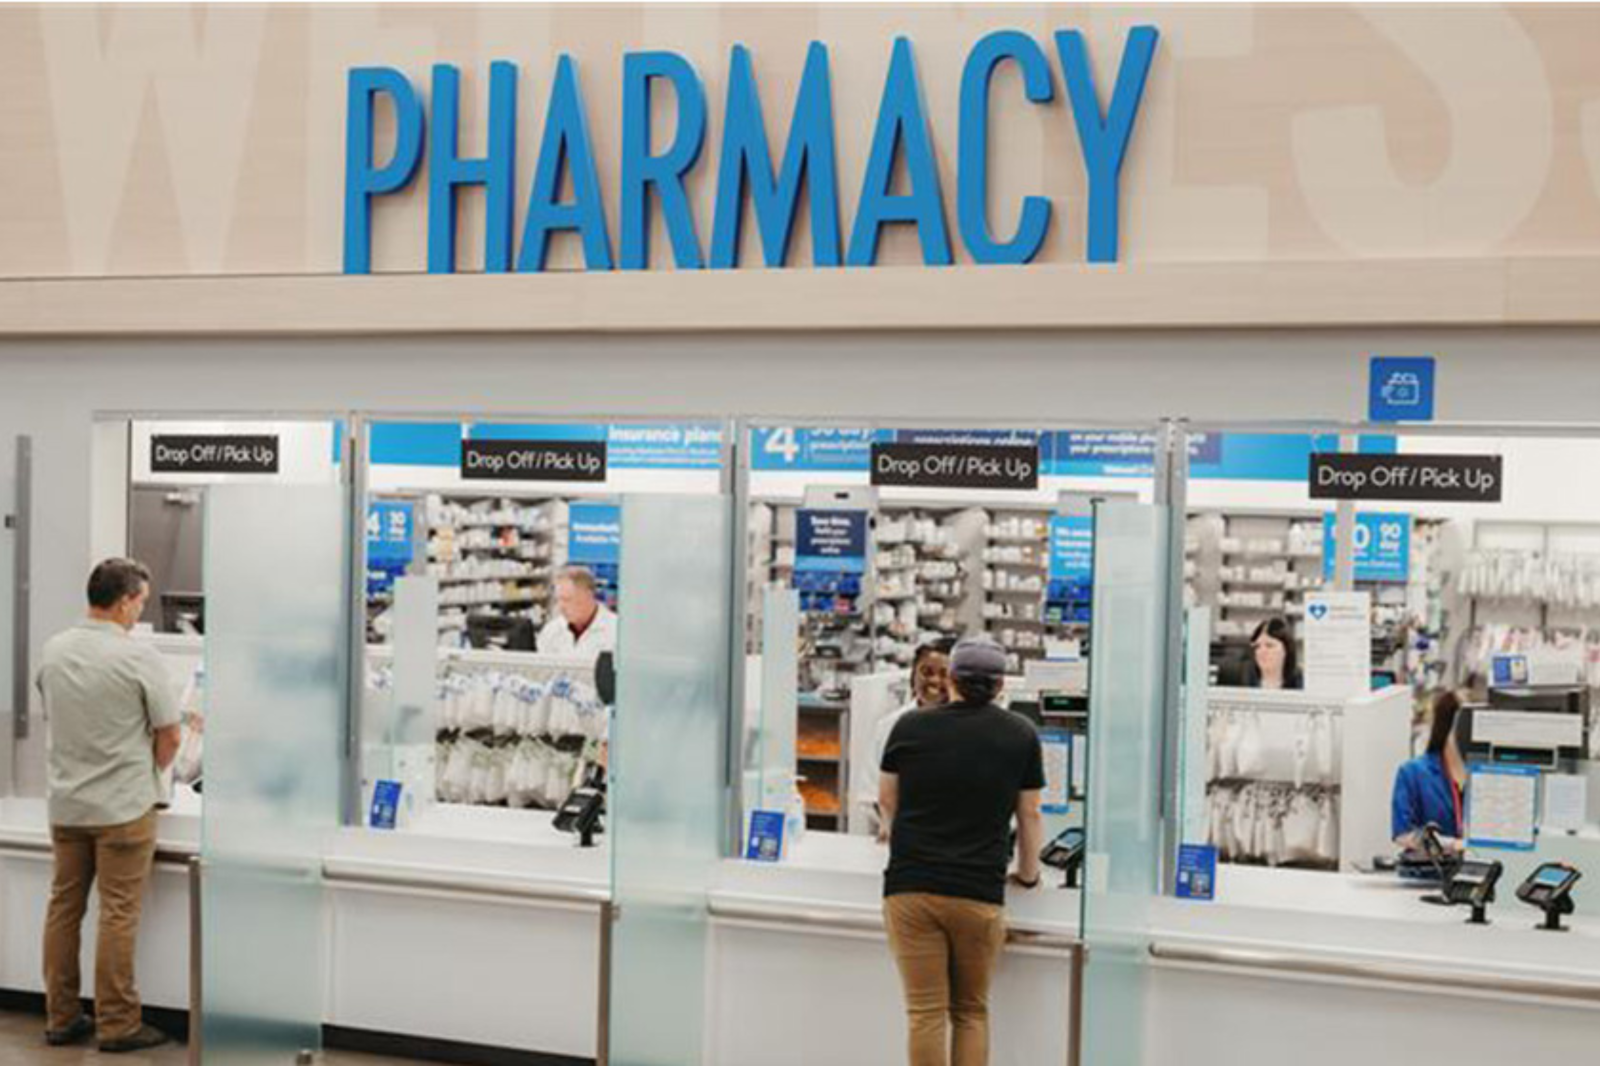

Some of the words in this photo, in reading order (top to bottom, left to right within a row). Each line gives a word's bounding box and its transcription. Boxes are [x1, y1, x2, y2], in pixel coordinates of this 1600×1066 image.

[342, 25, 1159, 274] PHARMACY
[155, 444, 189, 465] Drop
[253, 446, 274, 466] Up
[467, 450, 504, 472] Drop
[577, 453, 601, 474] Up
[877, 454, 921, 478] Drop
[1005, 458, 1031, 481] Up
[1317, 465, 1367, 491] Drop
[1464, 468, 1495, 493] Up
